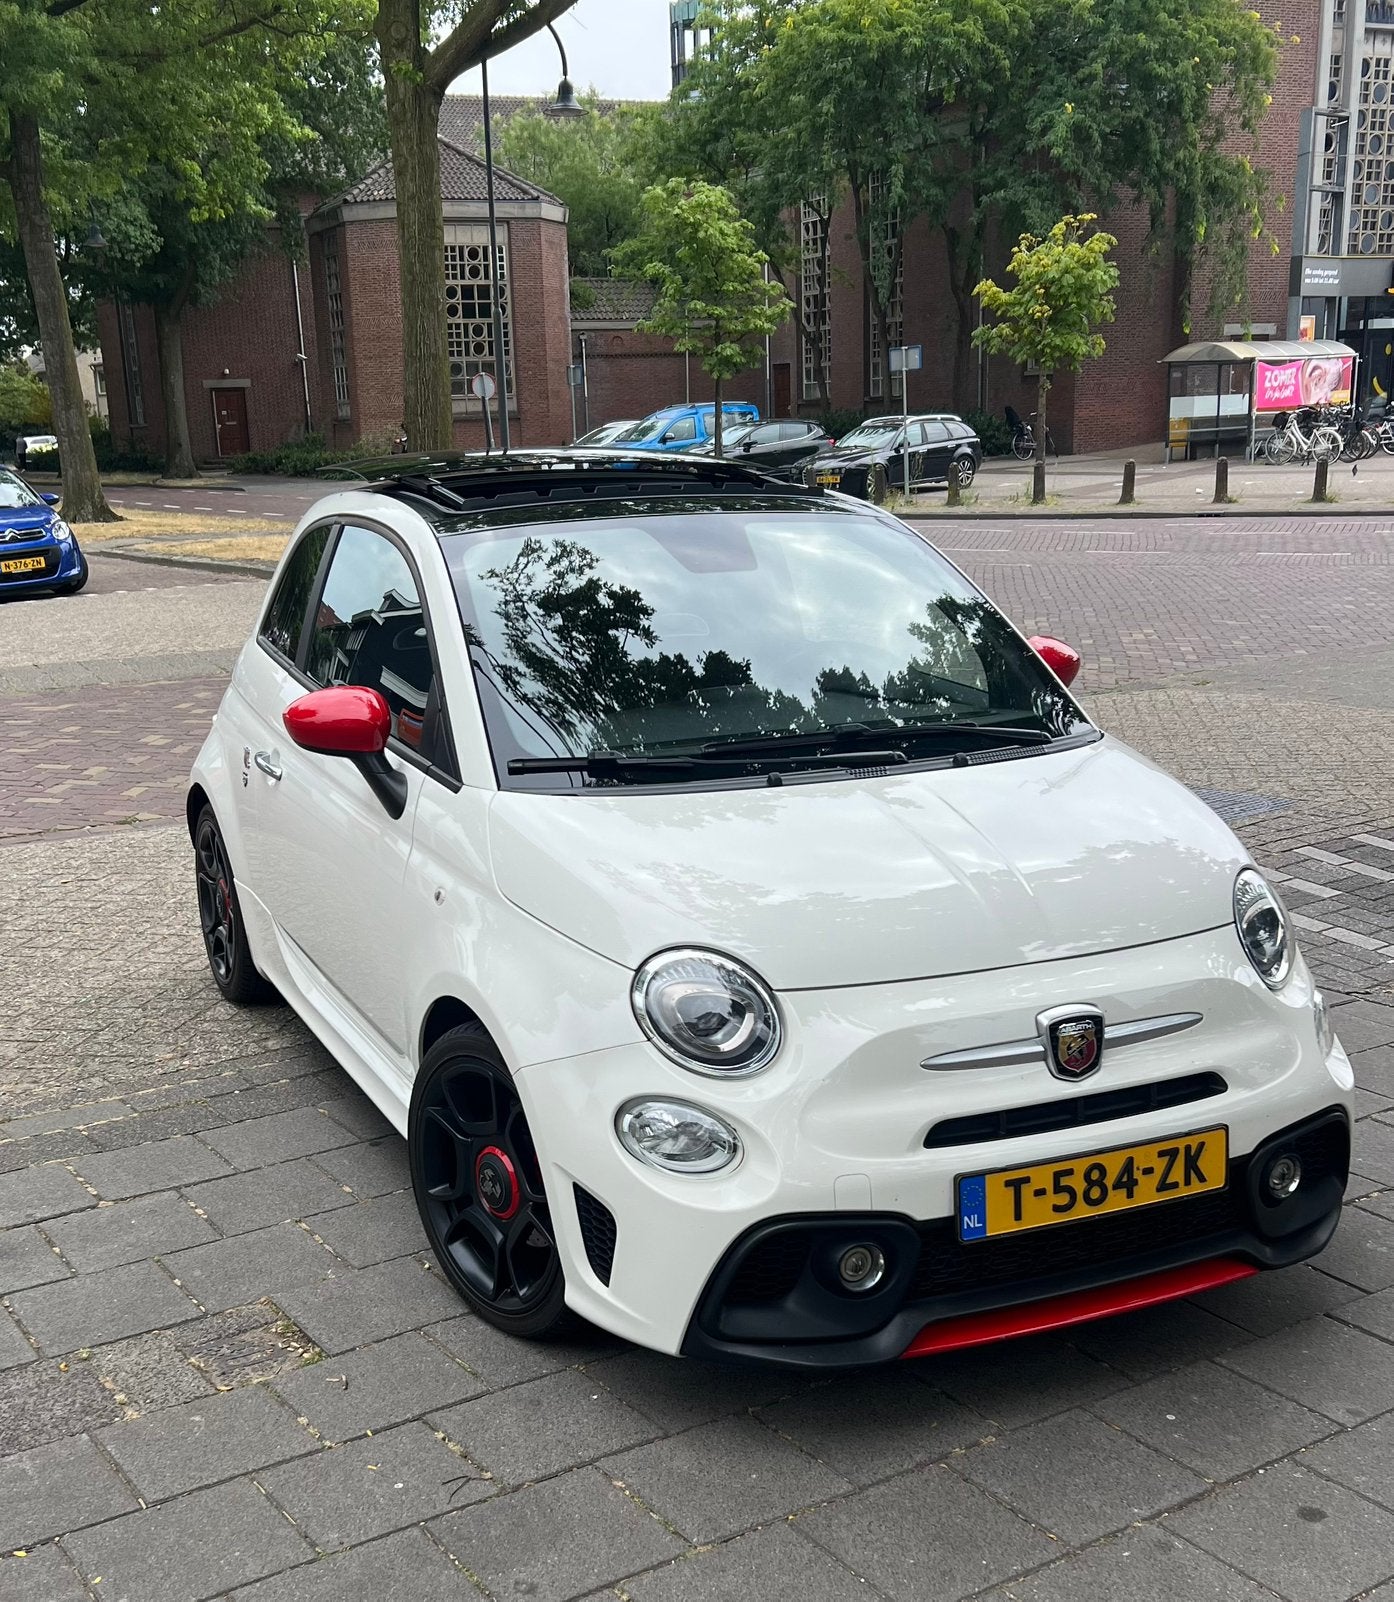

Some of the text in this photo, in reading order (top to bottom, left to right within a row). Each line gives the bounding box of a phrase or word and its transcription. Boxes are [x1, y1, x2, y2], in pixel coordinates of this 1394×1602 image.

[1264, 368, 1297, 388] ZOMER
[1060, 1023, 1092, 1033] ABARTH
[963, 1141, 1208, 1229] NL T-584-ZK
